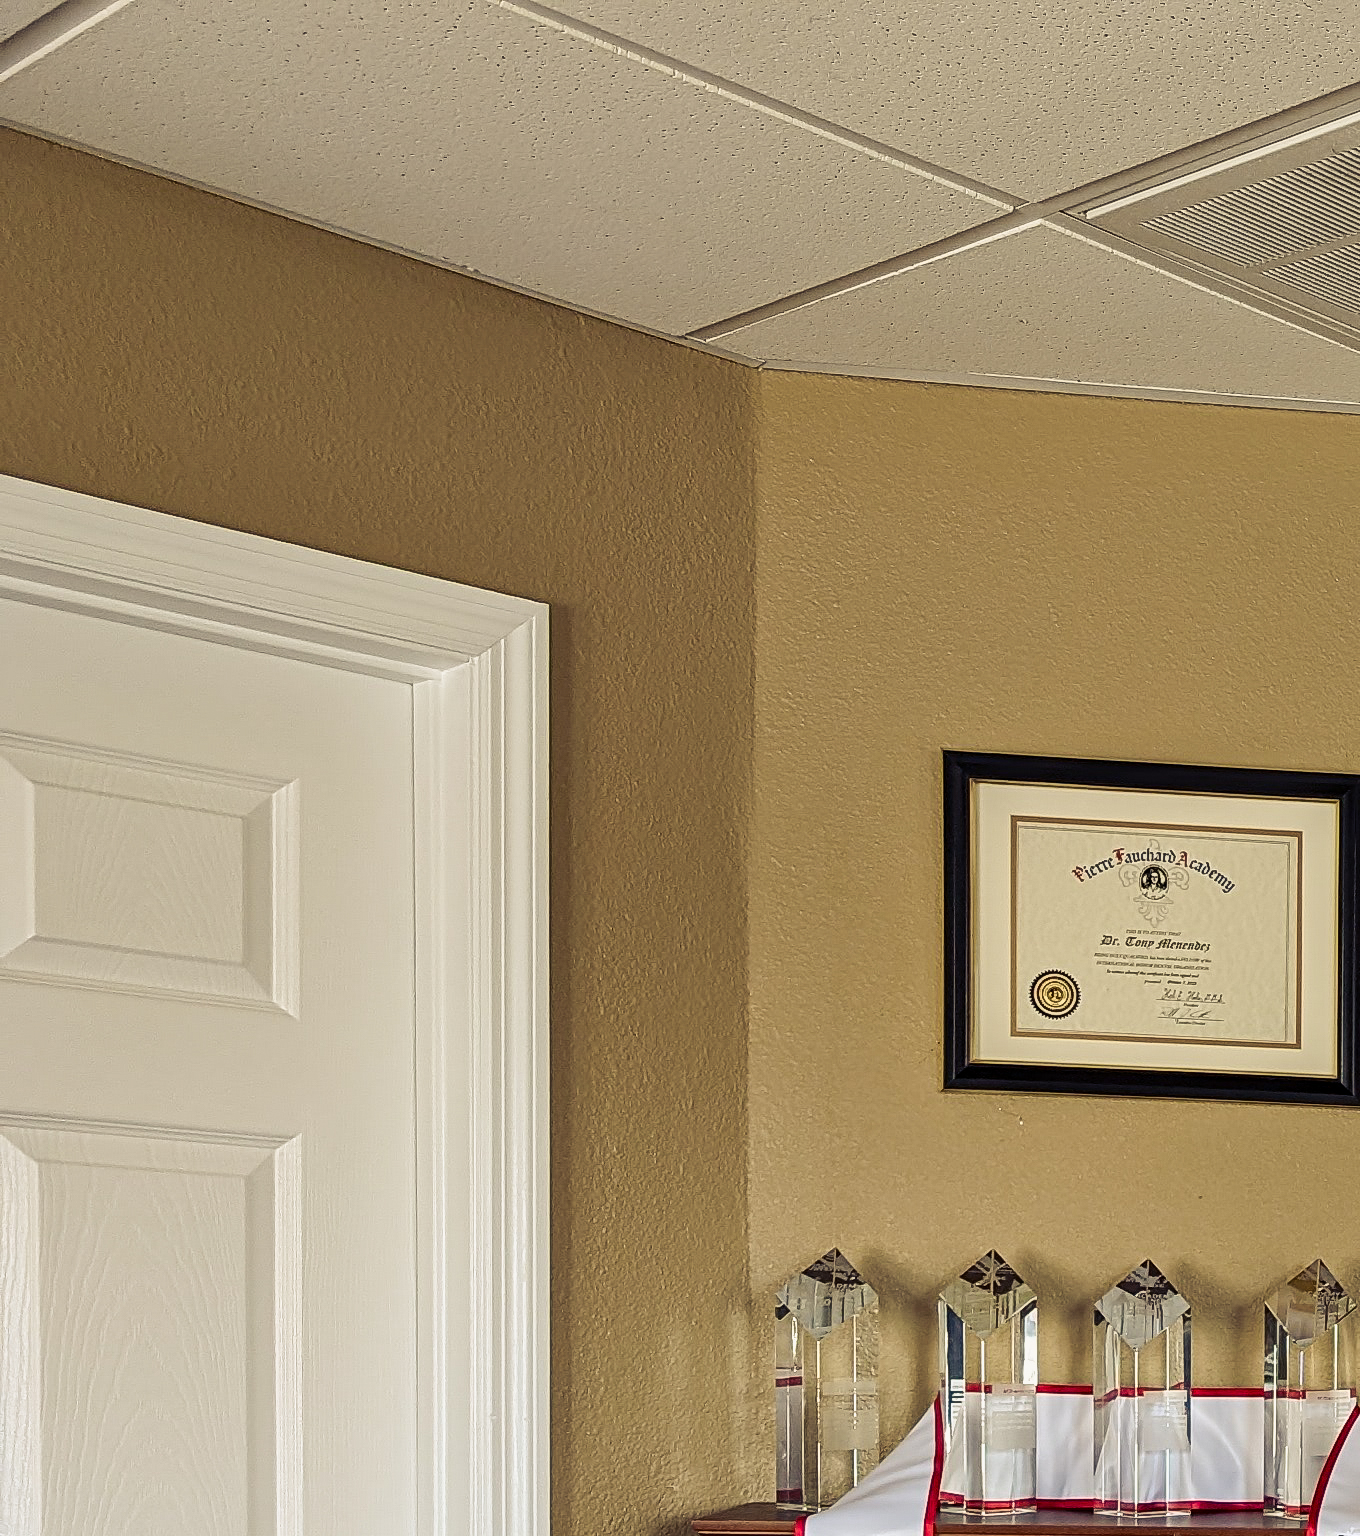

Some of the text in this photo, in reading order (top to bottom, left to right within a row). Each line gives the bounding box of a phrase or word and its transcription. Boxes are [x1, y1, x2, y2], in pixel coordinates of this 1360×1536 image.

[1072, 847, 1236, 894] Pierre Fauchard Academy
[1100, 934, 1212, 953] Dr. Tony Menendez
